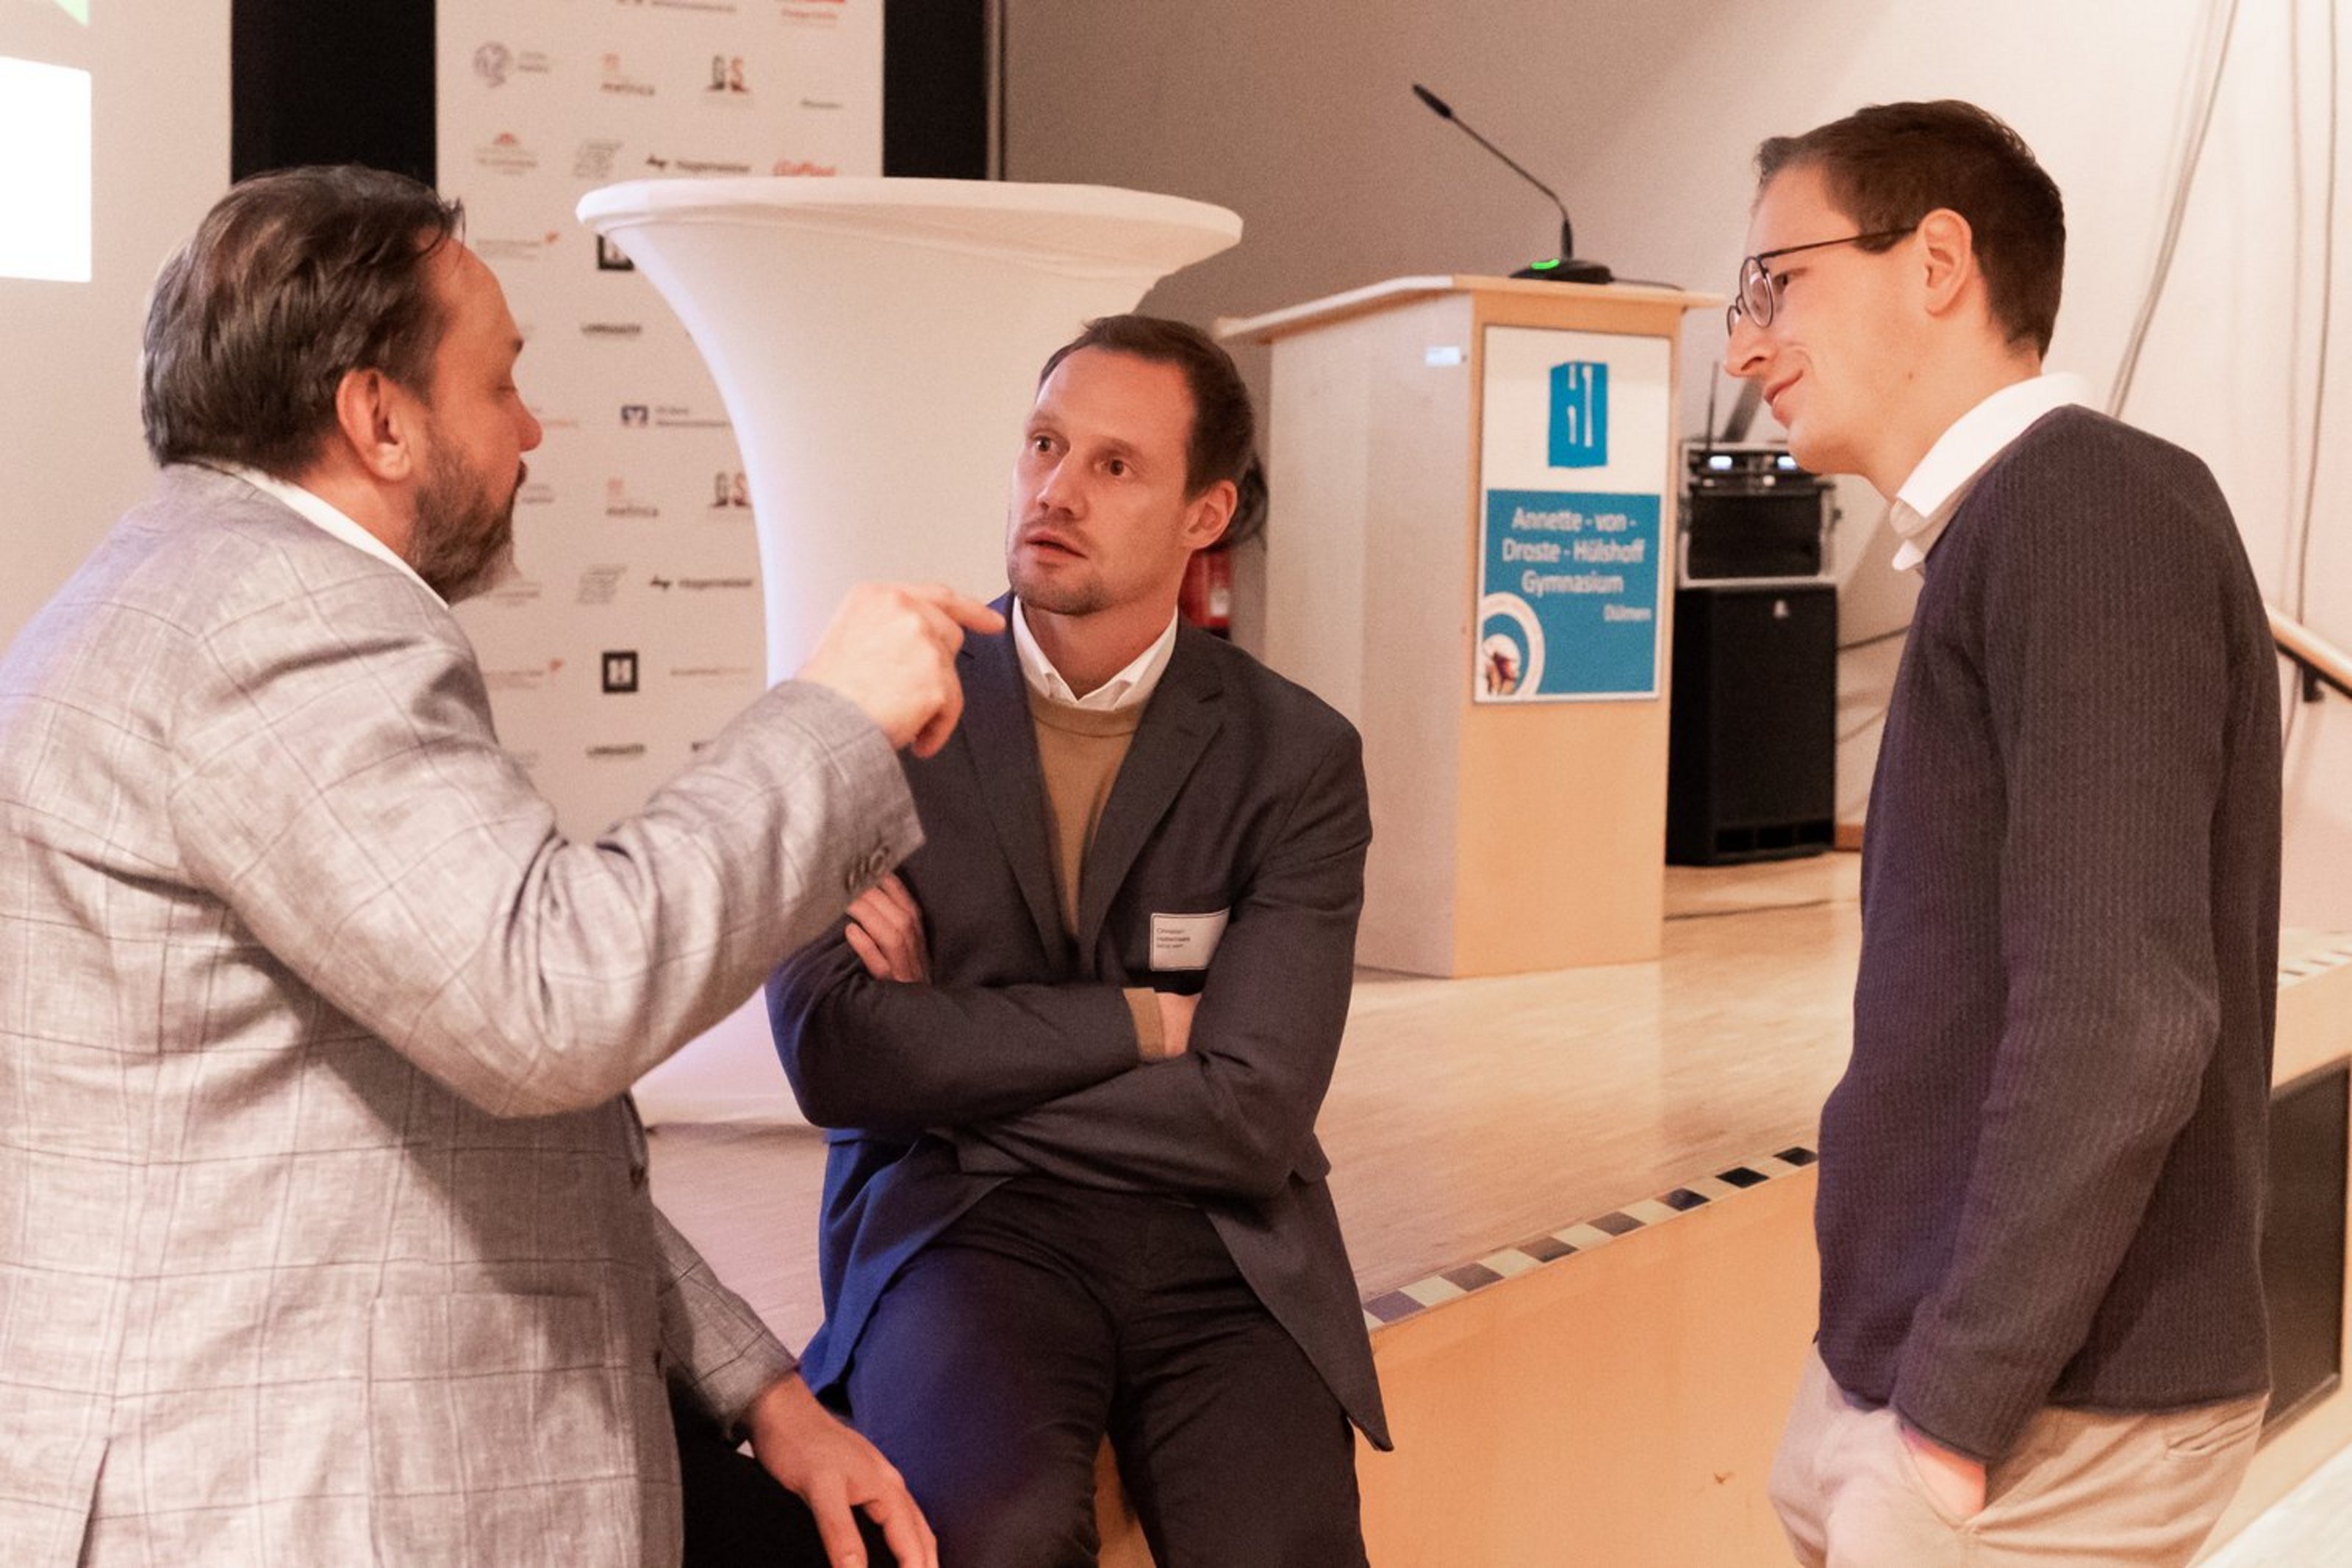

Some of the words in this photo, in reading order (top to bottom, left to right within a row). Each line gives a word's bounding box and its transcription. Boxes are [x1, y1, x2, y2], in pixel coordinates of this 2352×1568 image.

[1512, 507, 1582, 531] Annette
[1593, 512, 1627, 532] von
[1502, 537, 1562, 562] Droste
[1573, 539, 1645, 563] Hülshoff
[1521, 570, 1624, 597] Gymnasium
